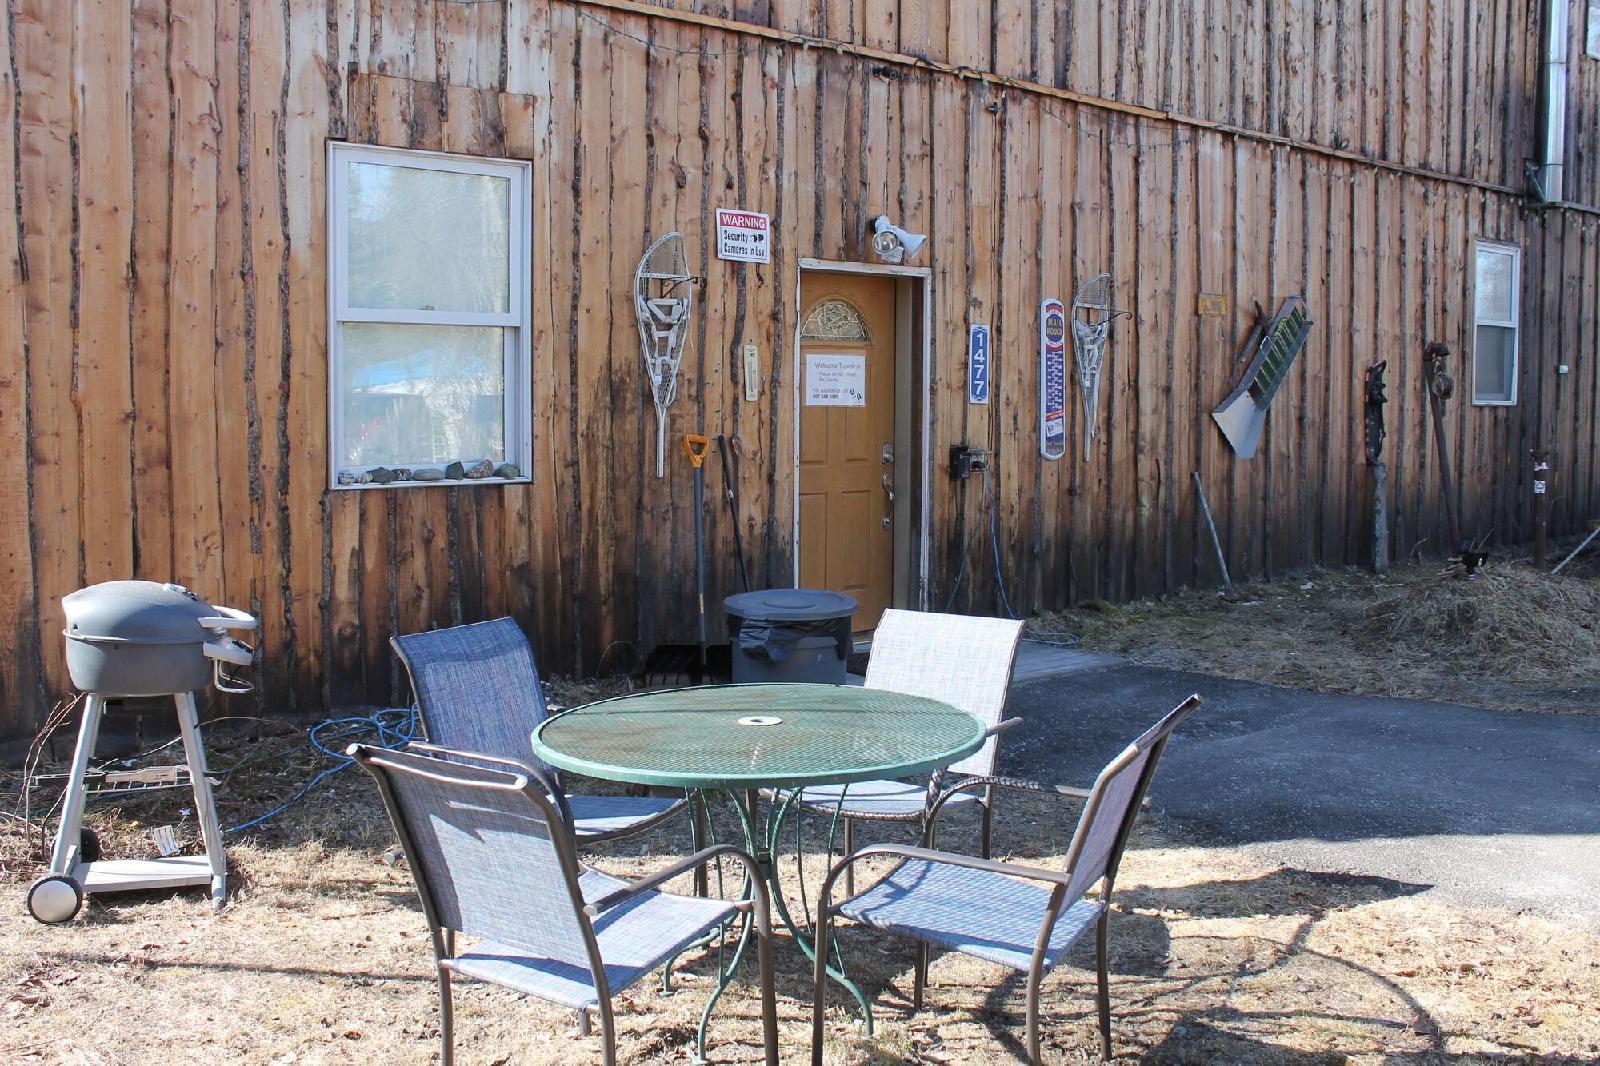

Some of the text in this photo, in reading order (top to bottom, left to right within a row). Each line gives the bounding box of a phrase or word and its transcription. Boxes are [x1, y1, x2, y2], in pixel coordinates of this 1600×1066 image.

[722, 214, 765, 229] WARNING
[724, 230, 749, 243] Security
[724, 243, 748, 255] Cameras
[750, 246, 755, 256] in
[973, 333, 985, 395] 1477
